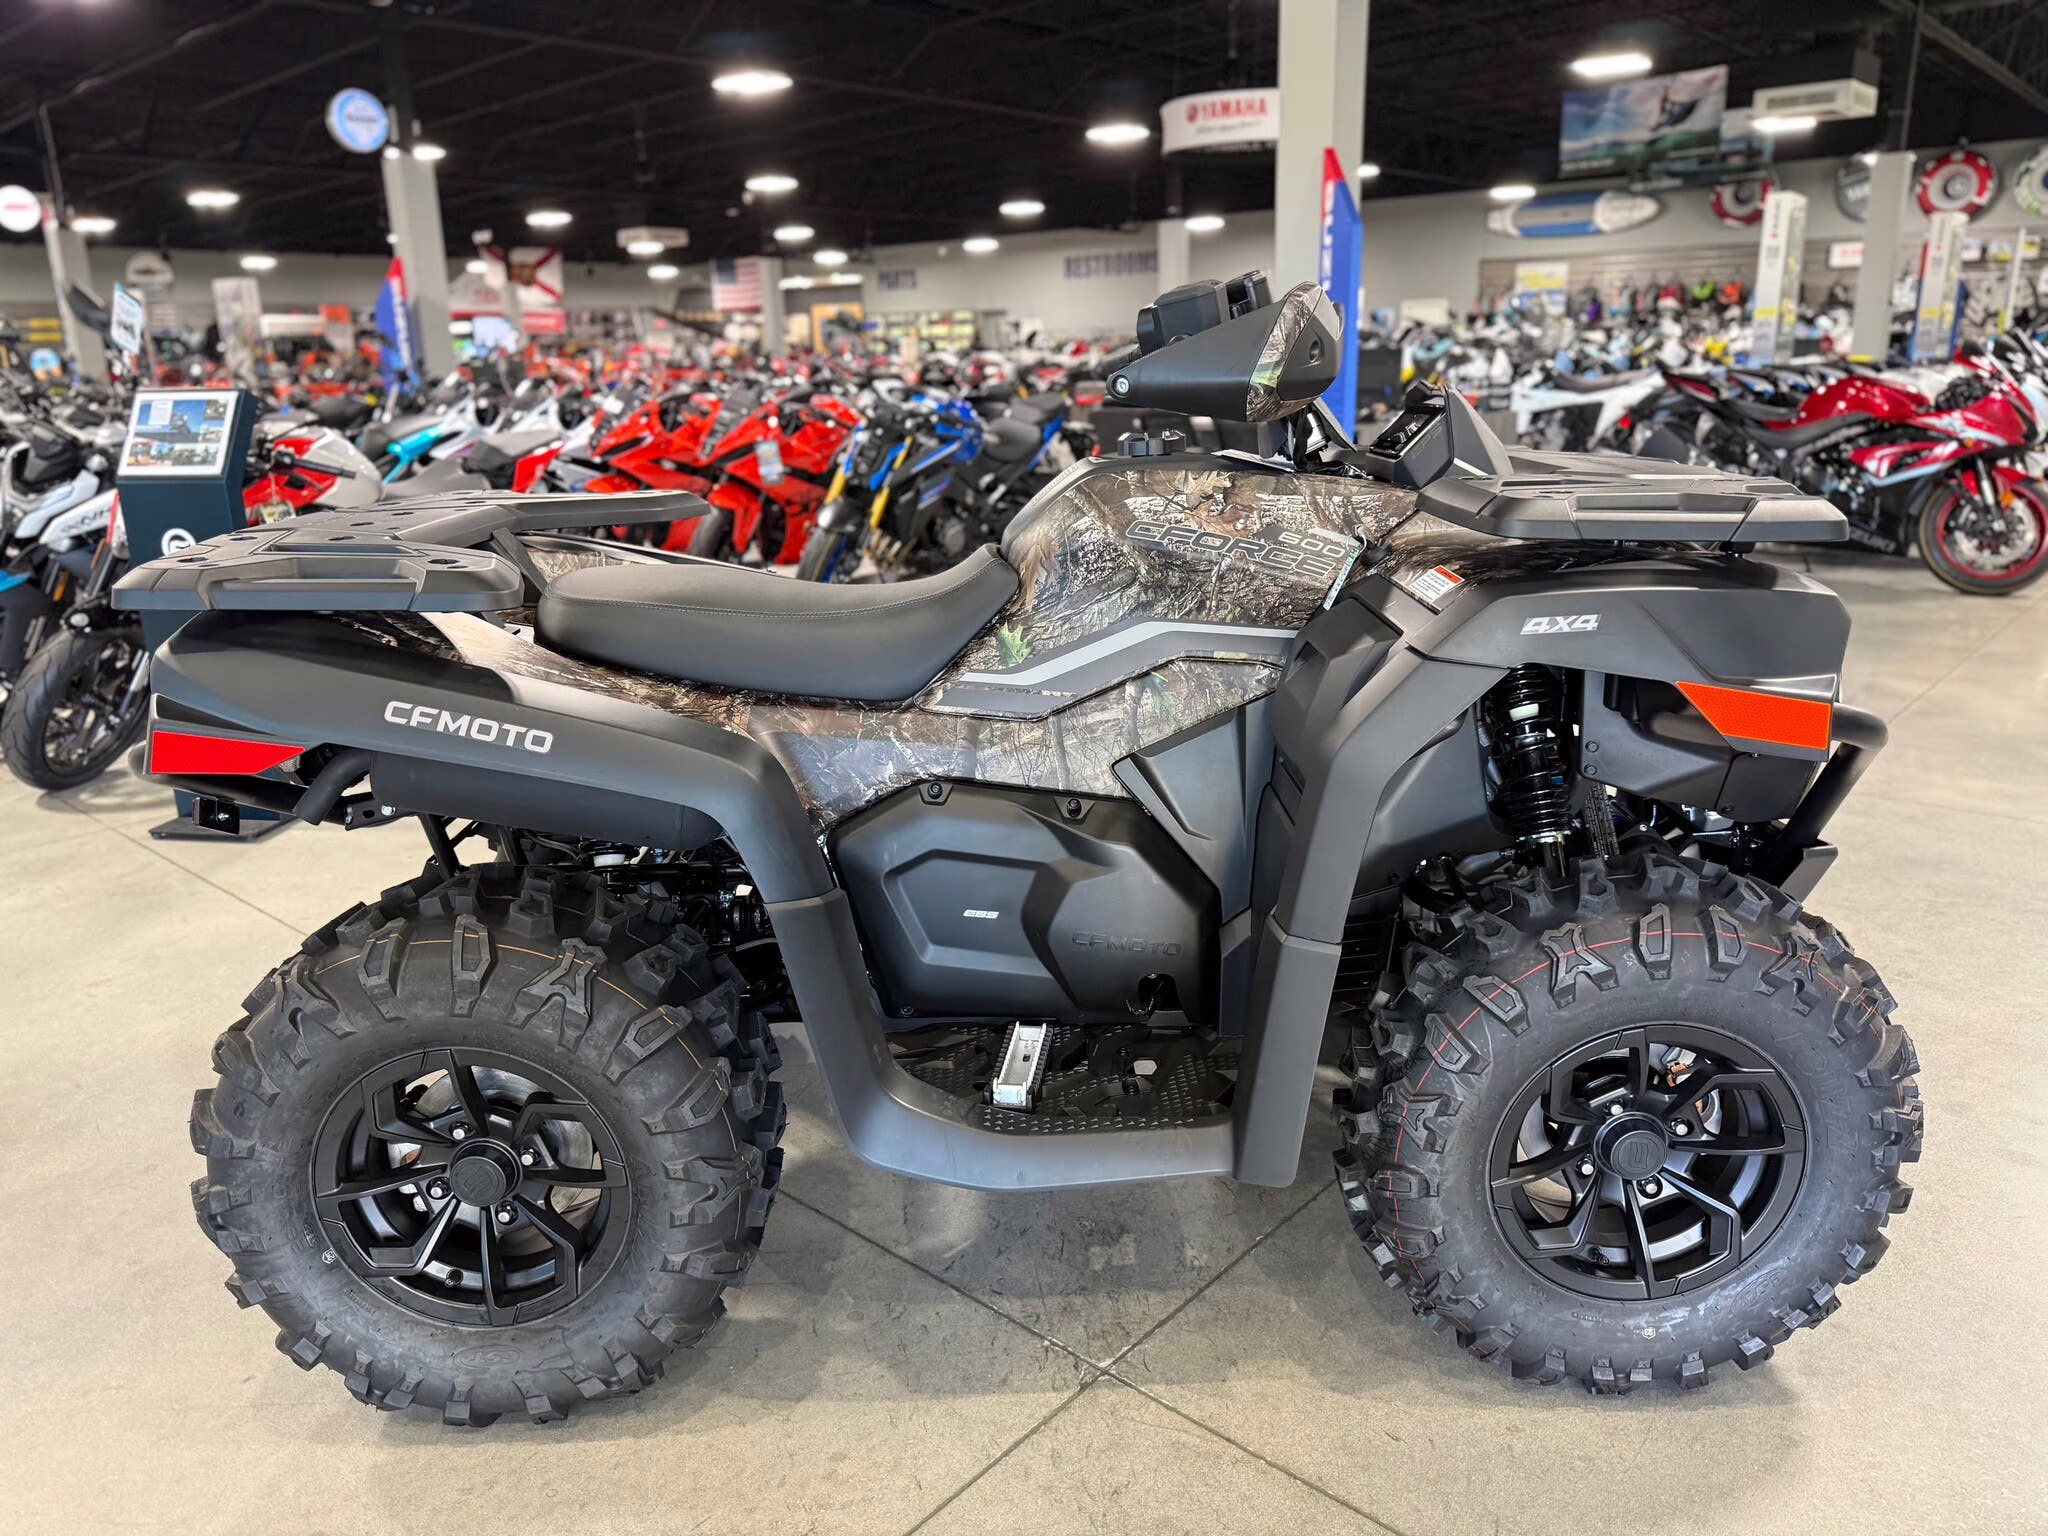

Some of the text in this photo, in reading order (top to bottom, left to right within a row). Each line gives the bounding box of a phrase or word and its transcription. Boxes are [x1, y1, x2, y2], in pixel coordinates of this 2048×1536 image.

[1201, 96, 1267, 120] YAMAHA
[1126, 519, 1336, 577] CFORCE
[384, 700, 554, 754] CFMOTO
[1072, 932, 1182, 957] CFMOTO
